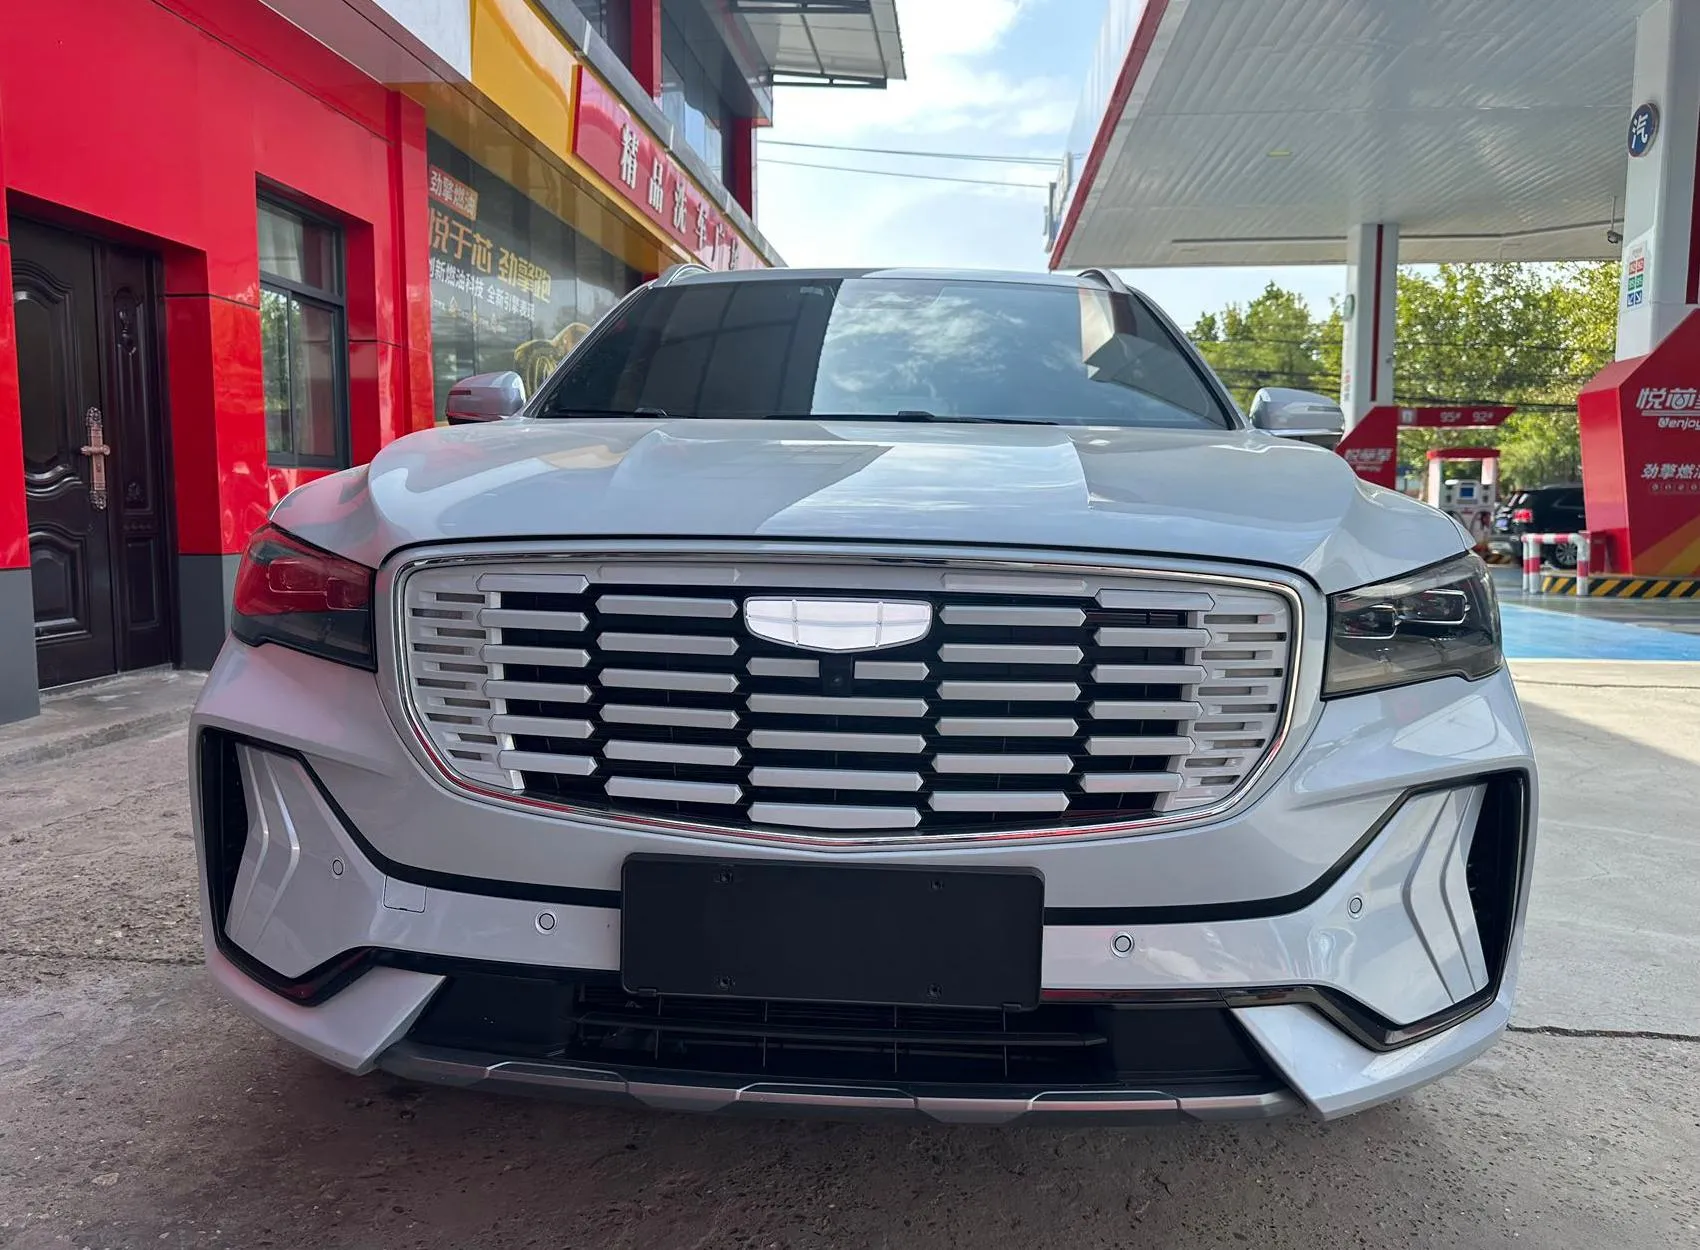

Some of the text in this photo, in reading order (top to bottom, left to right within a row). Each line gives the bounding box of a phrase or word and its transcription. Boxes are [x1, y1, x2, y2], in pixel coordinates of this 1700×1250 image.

[1632, 113, 1649, 149] 汽
[430, 170, 476, 215] 劲擎燃油
[1636, 388, 1700, 410] 悦芯
